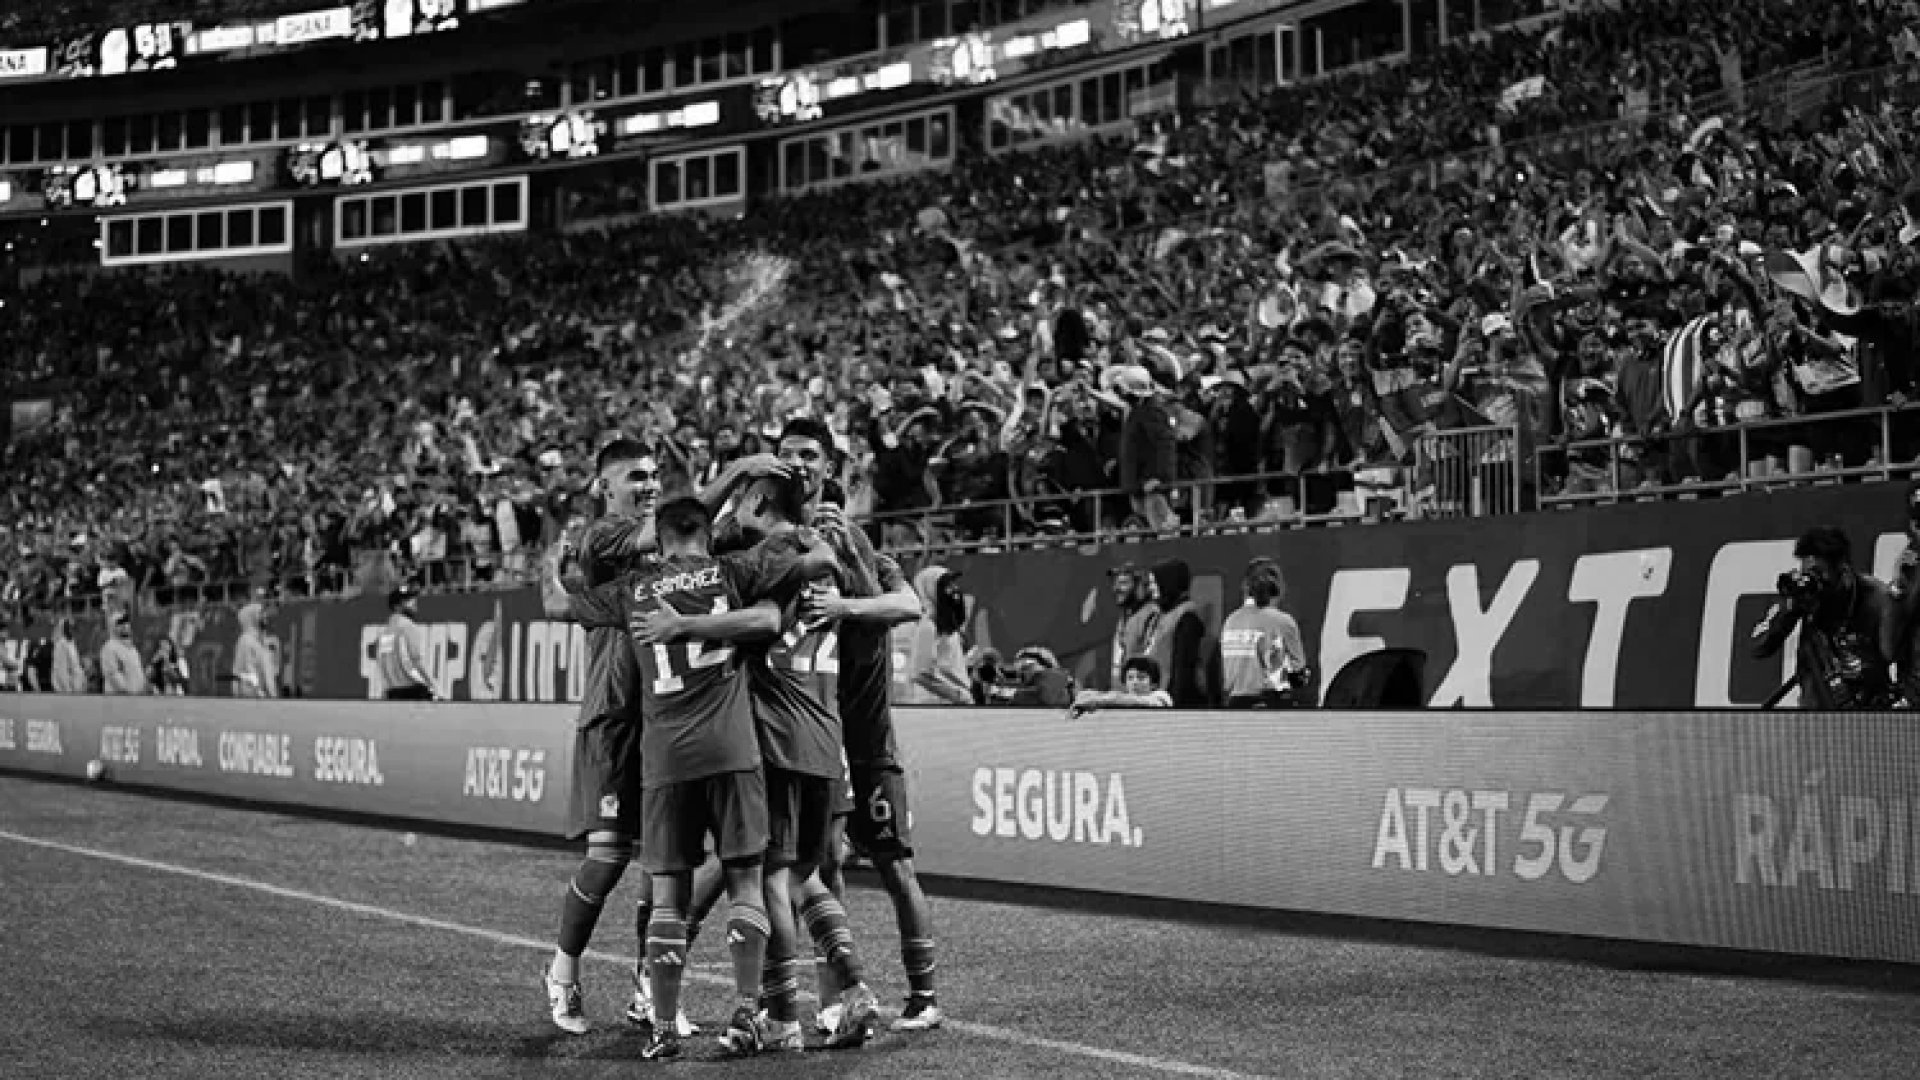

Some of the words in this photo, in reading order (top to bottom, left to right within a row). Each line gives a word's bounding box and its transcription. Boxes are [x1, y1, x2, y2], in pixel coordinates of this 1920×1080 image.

[463, 747, 512, 799] AT&T
[512, 748, 546, 802] 5G
[868, 785, 892, 821] 6
[970, 767, 1143, 848] SEGURA.
[1371, 787, 1508, 877] AT&T
[1514, 794, 1609, 884] 5G
